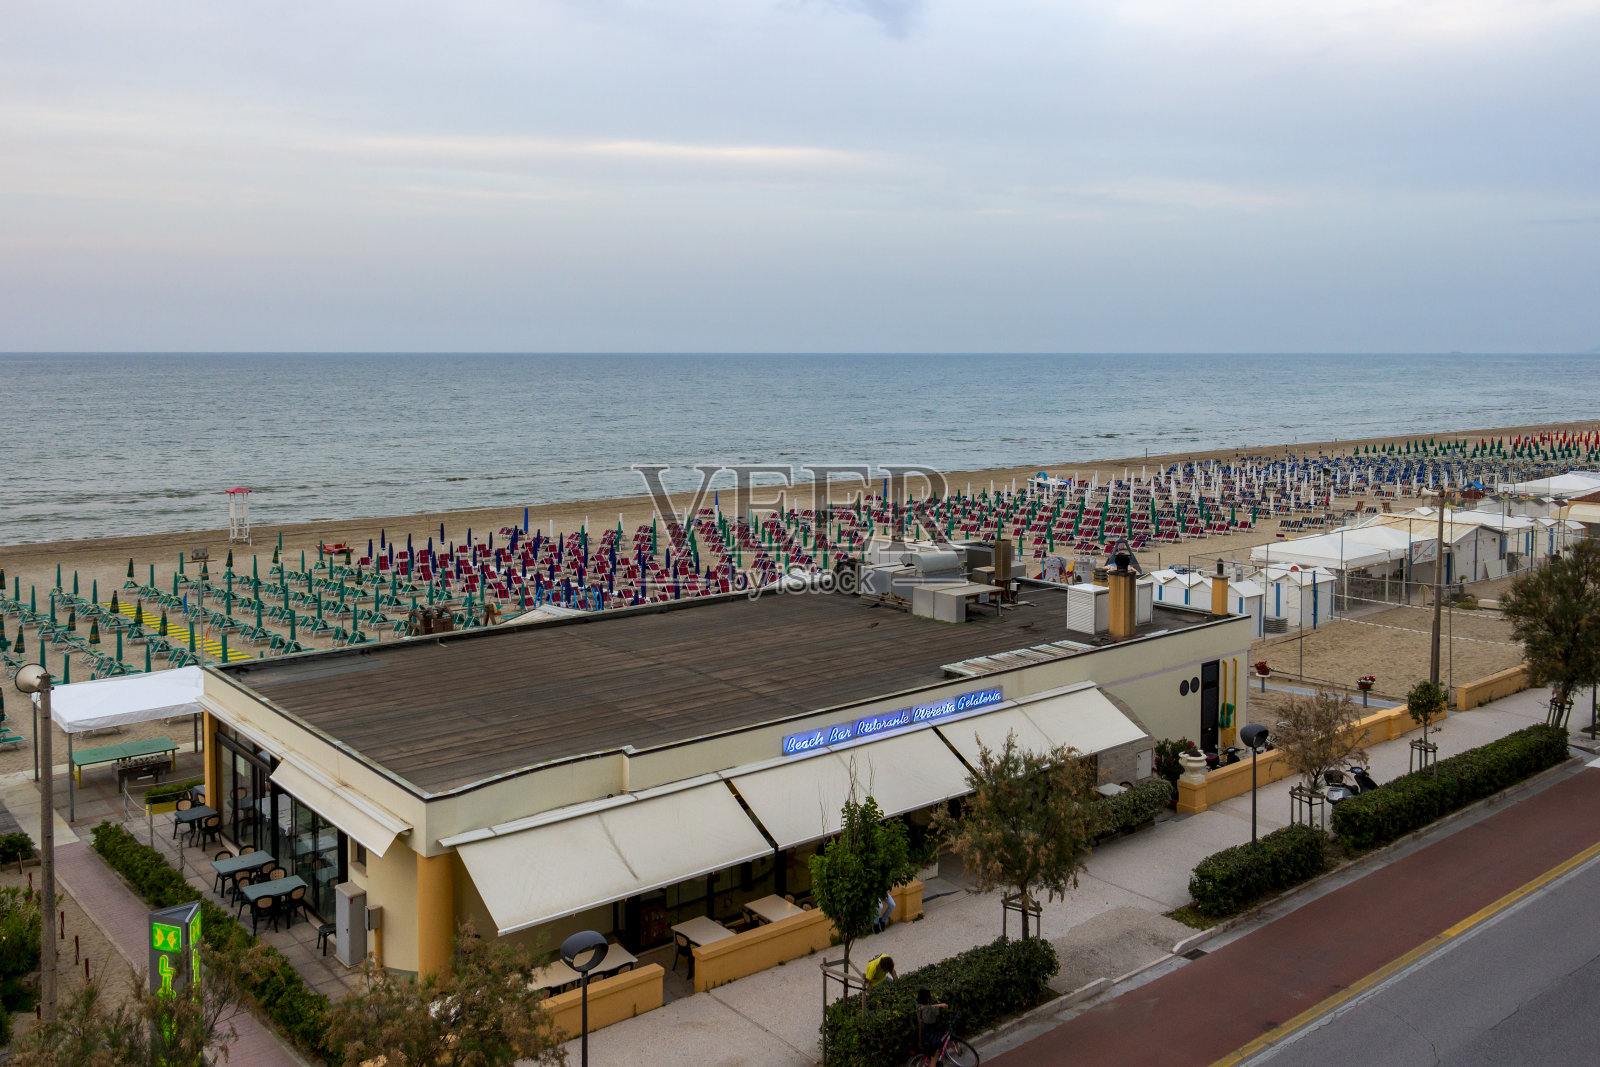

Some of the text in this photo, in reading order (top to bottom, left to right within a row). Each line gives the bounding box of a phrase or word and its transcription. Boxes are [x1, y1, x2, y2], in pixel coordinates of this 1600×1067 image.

[786, 690, 1001, 752] Beach Bar Ristorante Pizzeria Gelateria
